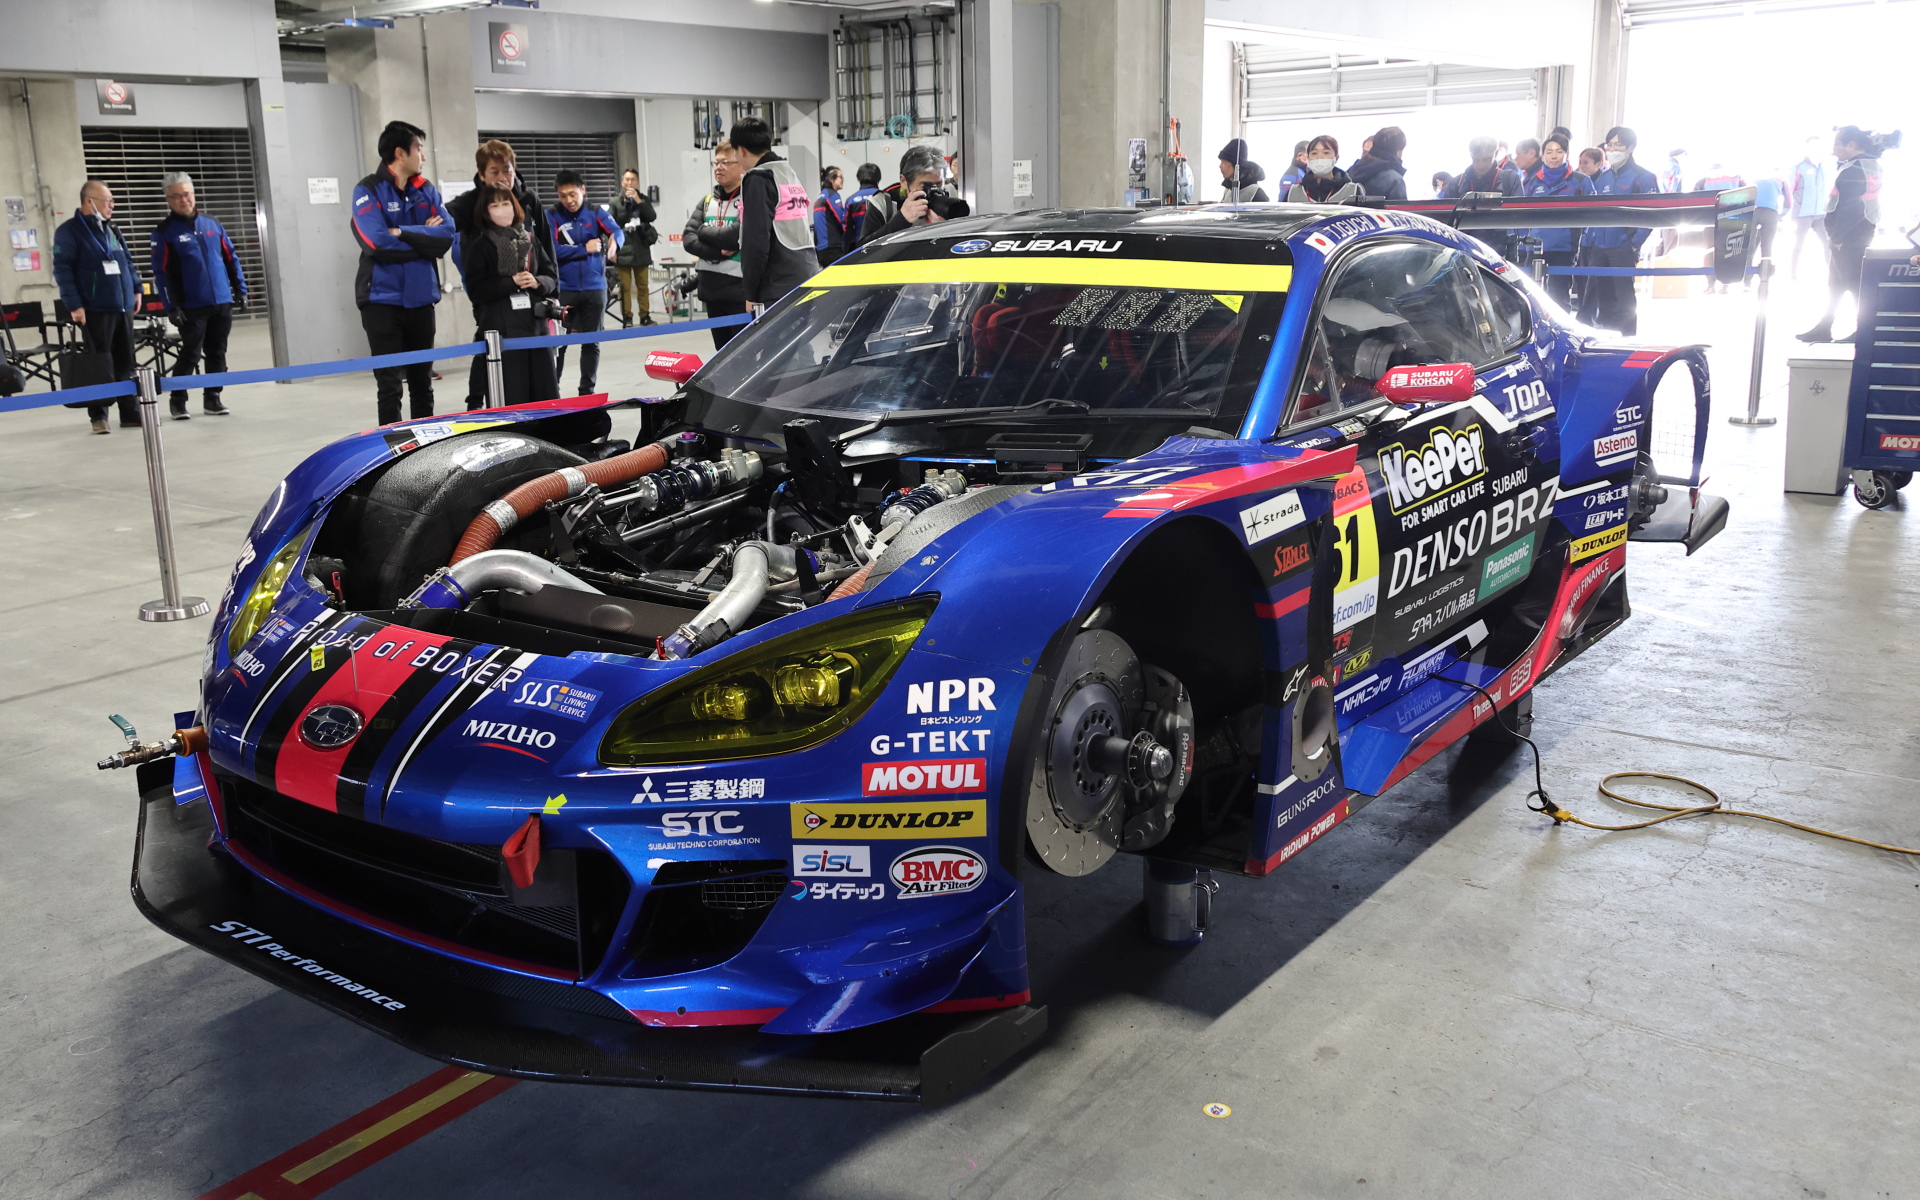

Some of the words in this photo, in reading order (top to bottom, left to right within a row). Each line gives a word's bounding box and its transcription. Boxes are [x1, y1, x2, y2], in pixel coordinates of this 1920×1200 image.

[504, 58, 526, 67] Smoking
[990, 239, 1123, 253] SUBARU
[1410, 369, 1453, 378] SUBARU
[1410, 376, 1453, 386] KOHSAN
[1616, 405, 1642, 424] STC
[1596, 434, 1636, 456] Astemo
[1381, 428, 1484, 509] KeePer
[1492, 467, 1528, 498] SUBARU
[1401, 513, 1421, 532] FOR
[1421, 503, 1450, 523] SMART
[1450, 494, 1468, 511] CAR
[1467, 484, 1486, 502] LIFE
[1597, 485, 1629, 506] 坂本工業
[1263, 503, 1300, 525] Strada
[1490, 475, 1561, 546] BRZ
[1581, 529, 1626, 553] DUNLOP
[1273, 542, 1311, 577] STANLEY
[1386, 509, 1486, 600] DENSO
[1485, 542, 1530, 580] Panasonic
[1490, 564, 1522, 589] AUTOMOTIVE
[1581, 558, 1610, 593] FINANCE
[1394, 596, 1427, 619] SUBARU
[1428, 575, 1465, 602] LOGISTICS
[1434, 588, 1476, 627] スバル用品
[291, 620, 378, 651] Proud
[373, 640, 416, 661] of
[411, 645, 525, 692] BOXER
[1509, 657, 1531, 697] BBS
[513, 681, 560, 707] SLS
[563, 696, 587, 709] LIVING
[568, 688, 597, 702] SUBARU
[906, 677, 997, 715] NPR
[557, 704, 587, 718] SERVICE
[920, 715, 983, 726] 日本ピストンリング
[462, 719, 557, 749] MIZUHO
[870, 729, 991, 756] G-TEKT
[868, 763, 981, 791] MOTUL
[664, 778, 766, 802] 三菱製鋼
[661, 810, 744, 837] STC
[829, 810, 975, 829] DUNLOP
[648, 841, 677, 851] SUBARU
[677, 840, 706, 850] TECHNO
[707, 837, 761, 848] CORPORATION
[1280, 832, 1310, 863] IRIDIUM
[1310, 812, 1336, 840] POWER
[901, 859, 975, 882] BMC
[809, 882, 885, 900] ダイテック
[902, 881, 938, 894] Air
[938, 881, 969, 891] Filter
[209, 920, 273, 944] STI
[257, 942, 407, 1011] Performance
